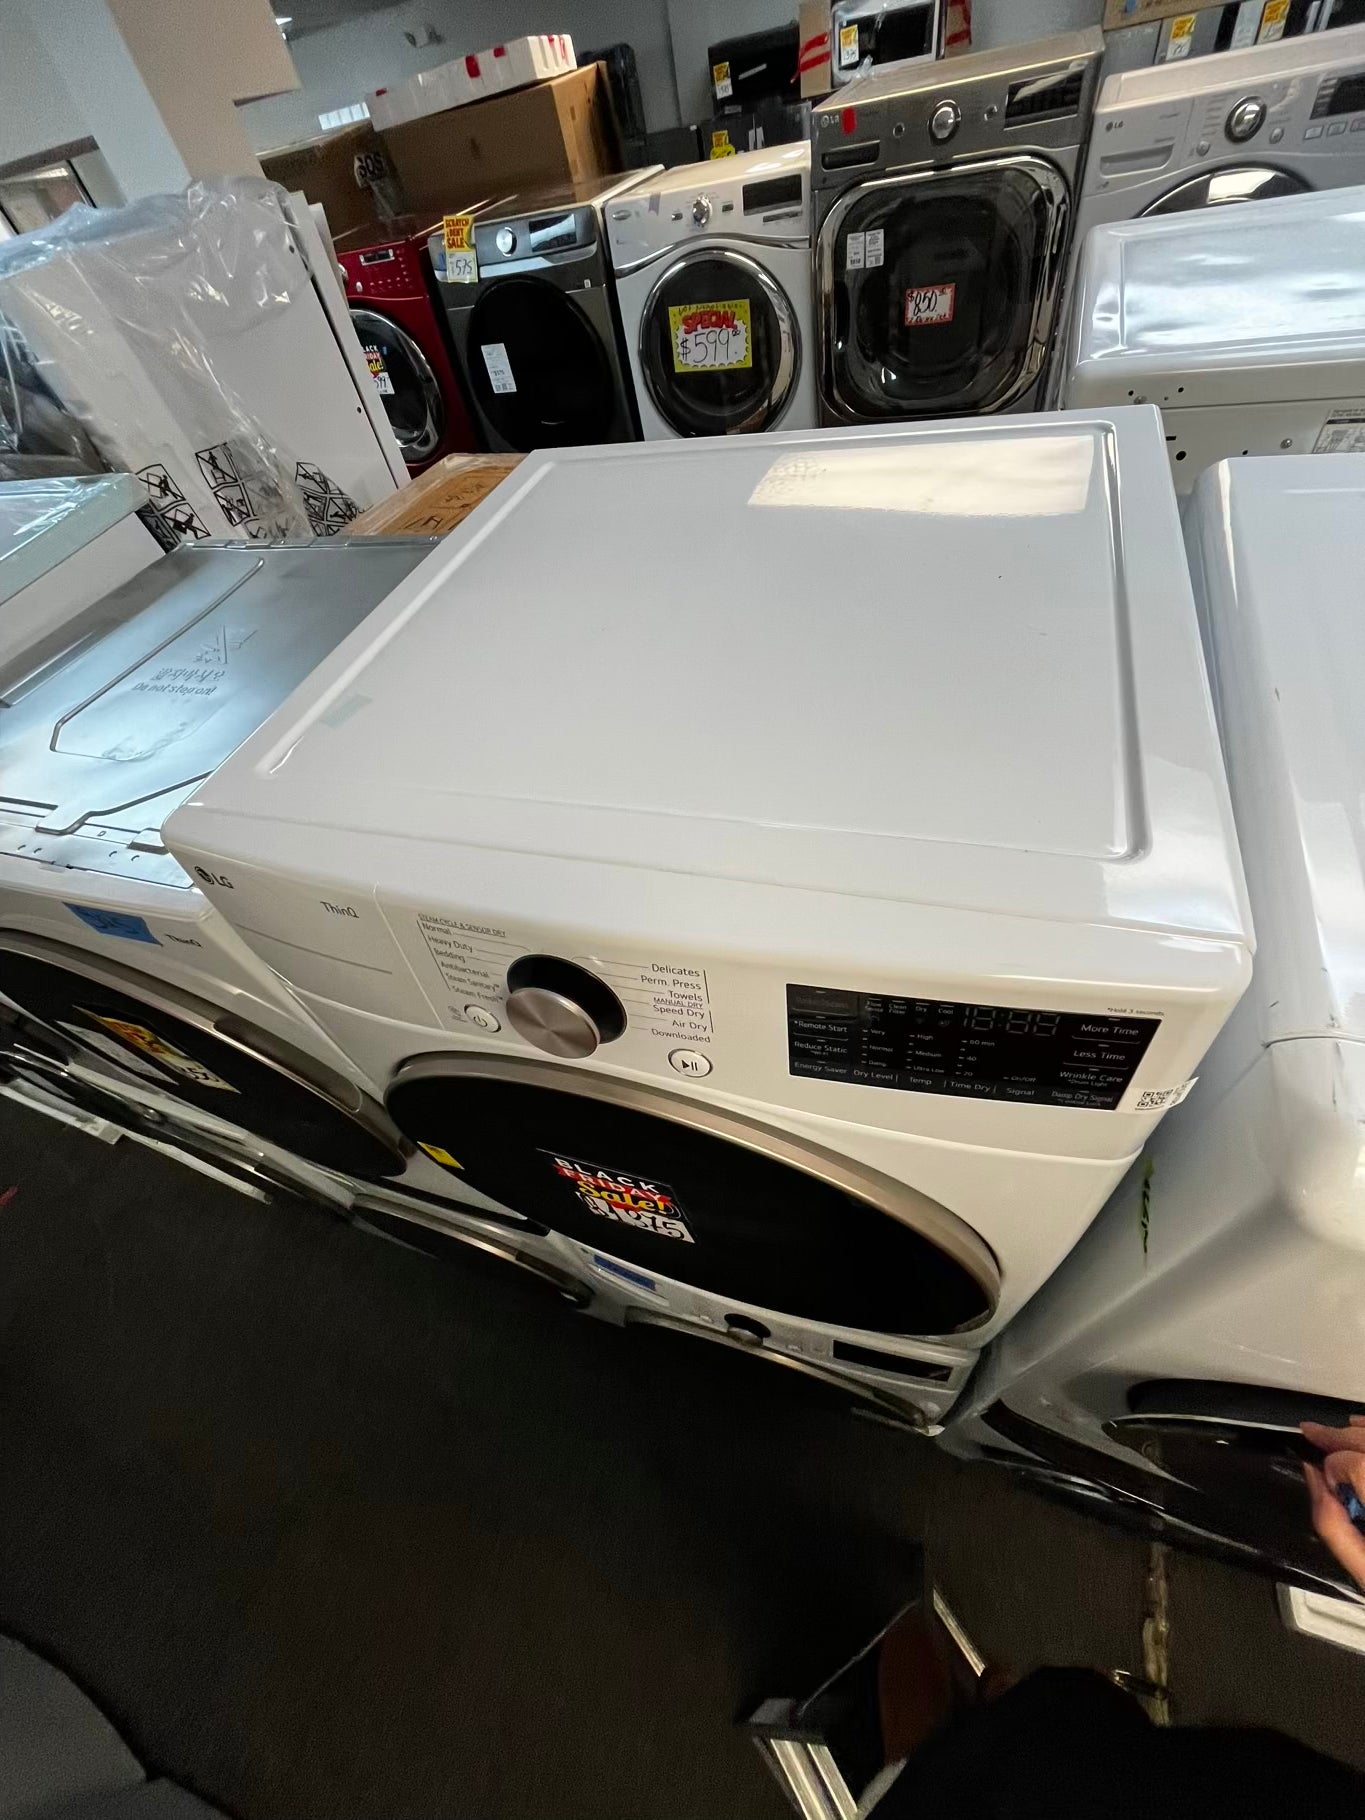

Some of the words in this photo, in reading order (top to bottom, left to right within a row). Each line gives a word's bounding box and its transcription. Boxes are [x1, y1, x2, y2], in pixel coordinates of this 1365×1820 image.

[446, 238, 466, 249] SALE
[320, 901, 360, 919] ThinQ
[422, 922, 452, 936] Normal
[427, 935, 452, 948] Heavy
[453, 940, 473, 953] Duty
[433, 947, 466, 963] Bedding
[651, 963, 701, 977] Delicates
[640, 975, 671, 987] Perm.
[672, 979, 702, 990] Press
[668, 990, 703, 1002] Towels
[653, 997, 684, 1007] MANUAL
[687, 1001, 704, 1009] DRY
[652, 1004, 684, 1016] Speed
[686, 1008, 705, 1020] Dry
[938, 1007, 954, 1015] Cool
[672, 1019, 686, 1028] Air
[689, 1021, 708, 1033] Dry
[828, 1024, 848, 1033] Start
[870, 1028, 886, 1036] Very
[1081, 1024, 1110, 1034] More
[1113, 1026, 1139, 1036] Time
[651, 1028, 711, 1043] Downloaded
[794, 1041, 822, 1051] Reduce
[824, 1044, 848, 1054] Static
[869, 1044, 893, 1053] Normal
[915, 1050, 942, 1058] Medium
[1073, 1050, 1097, 1059] Less
[1101, 1052, 1126, 1061] Time
[794, 1062, 823, 1072] Energy
[824, 1066, 848, 1075] Saver
[853, 1069, 869, 1079] Dry
[871, 1072, 894, 1081] Level
[1059, 1071, 1097, 1081] Wrinkle
[1099, 1074, 1124, 1083] Care
[910, 1077, 933, 1086] Temp
[950, 1082, 972, 1090] Time
[974, 1083, 991, 1093] Dry
[1006, 1088, 1036, 1097] Signal
[1075, 1093, 1089, 1102] Dry
[554, 1157, 661, 1194] BLACK
[562, 1168, 662, 1201] FRIDAY
[576, 1180, 667, 1215] Sale!
